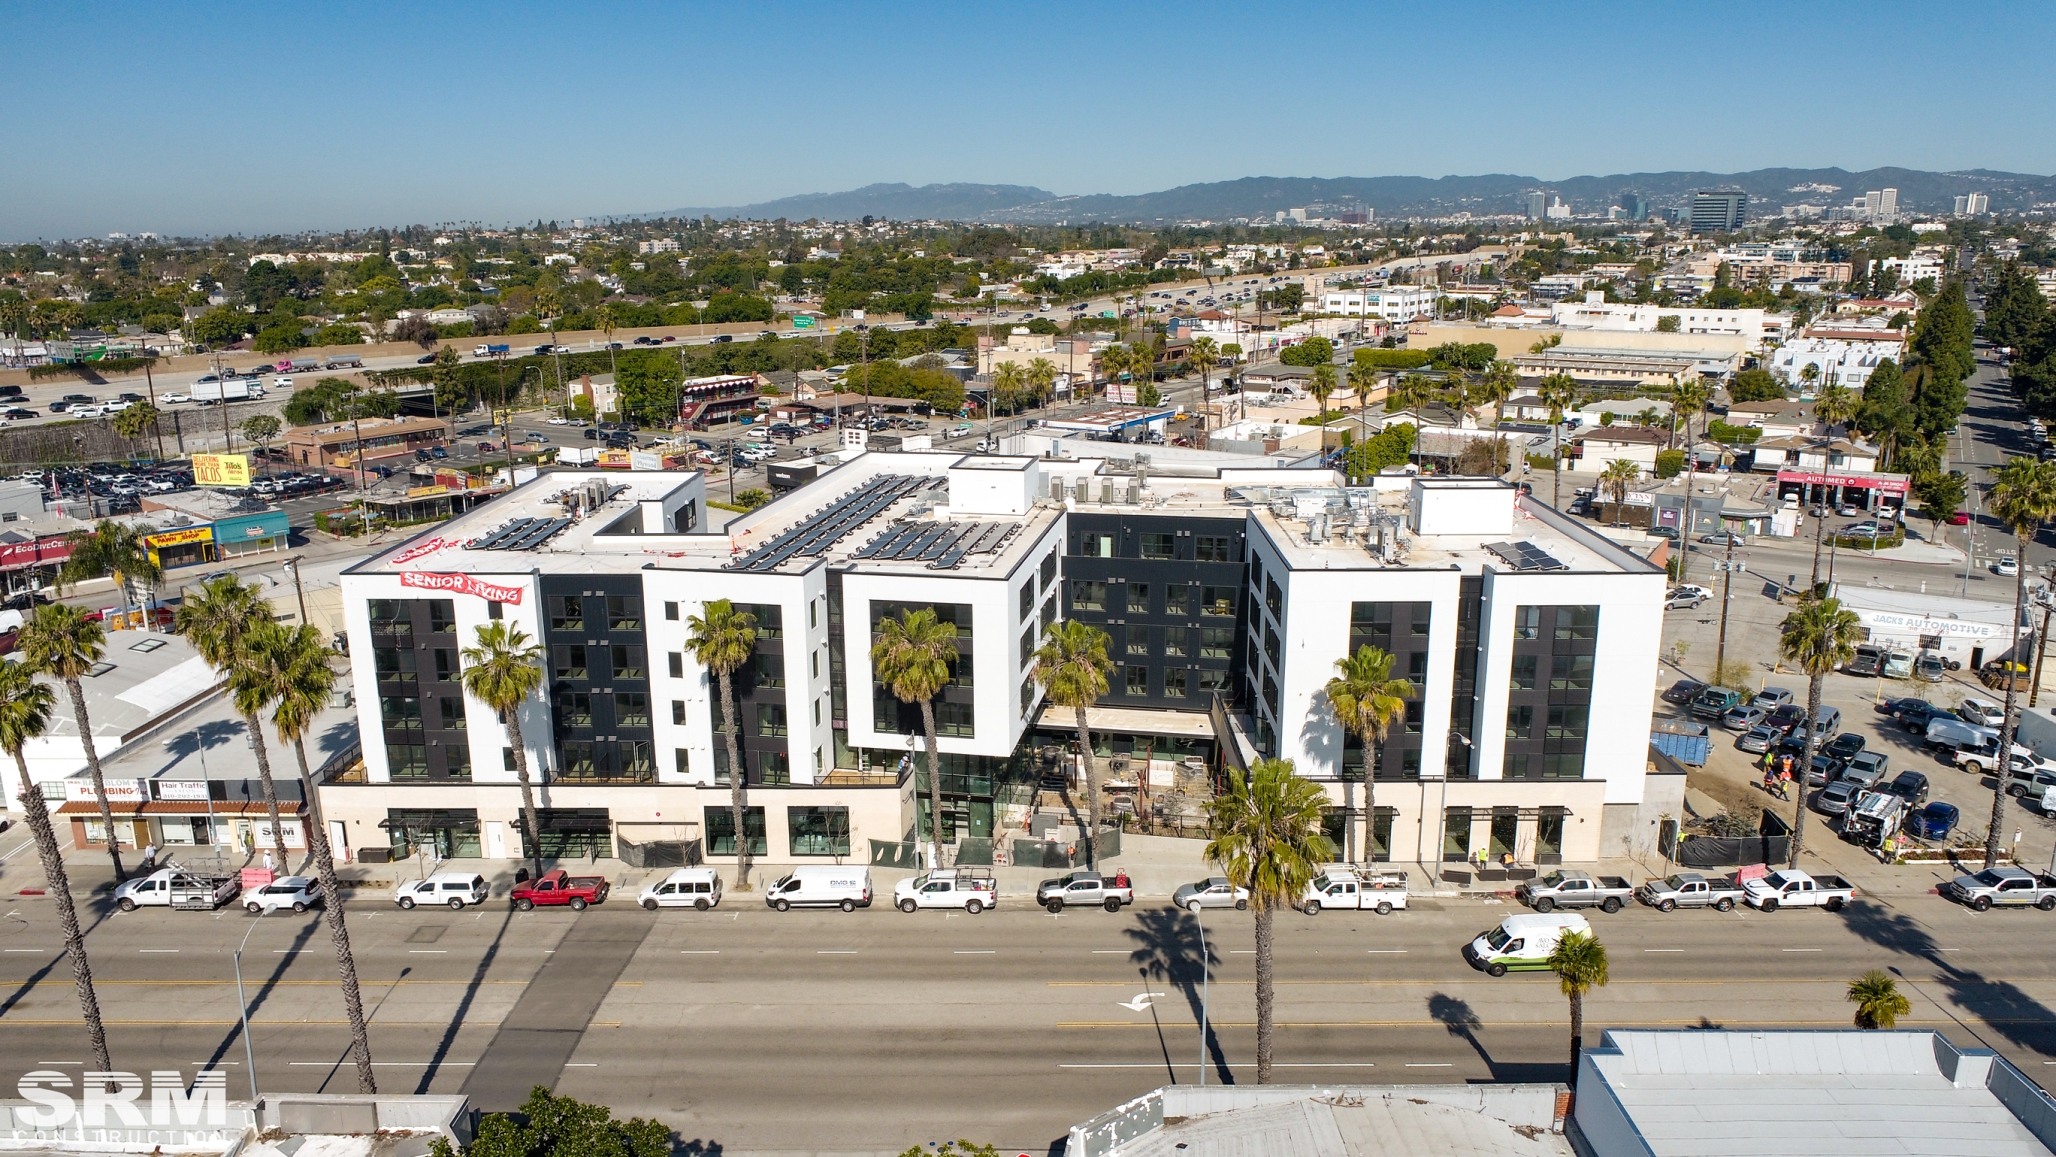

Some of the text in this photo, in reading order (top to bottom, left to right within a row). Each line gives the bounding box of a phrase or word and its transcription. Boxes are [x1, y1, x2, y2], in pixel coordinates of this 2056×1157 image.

[195, 467, 222, 482] TACOS
[404, 572, 518, 600] SENIOR LIVING
[1873, 614, 1989, 636] JACKS AUTOMOTIVE
[262, 827, 295, 836] SM
